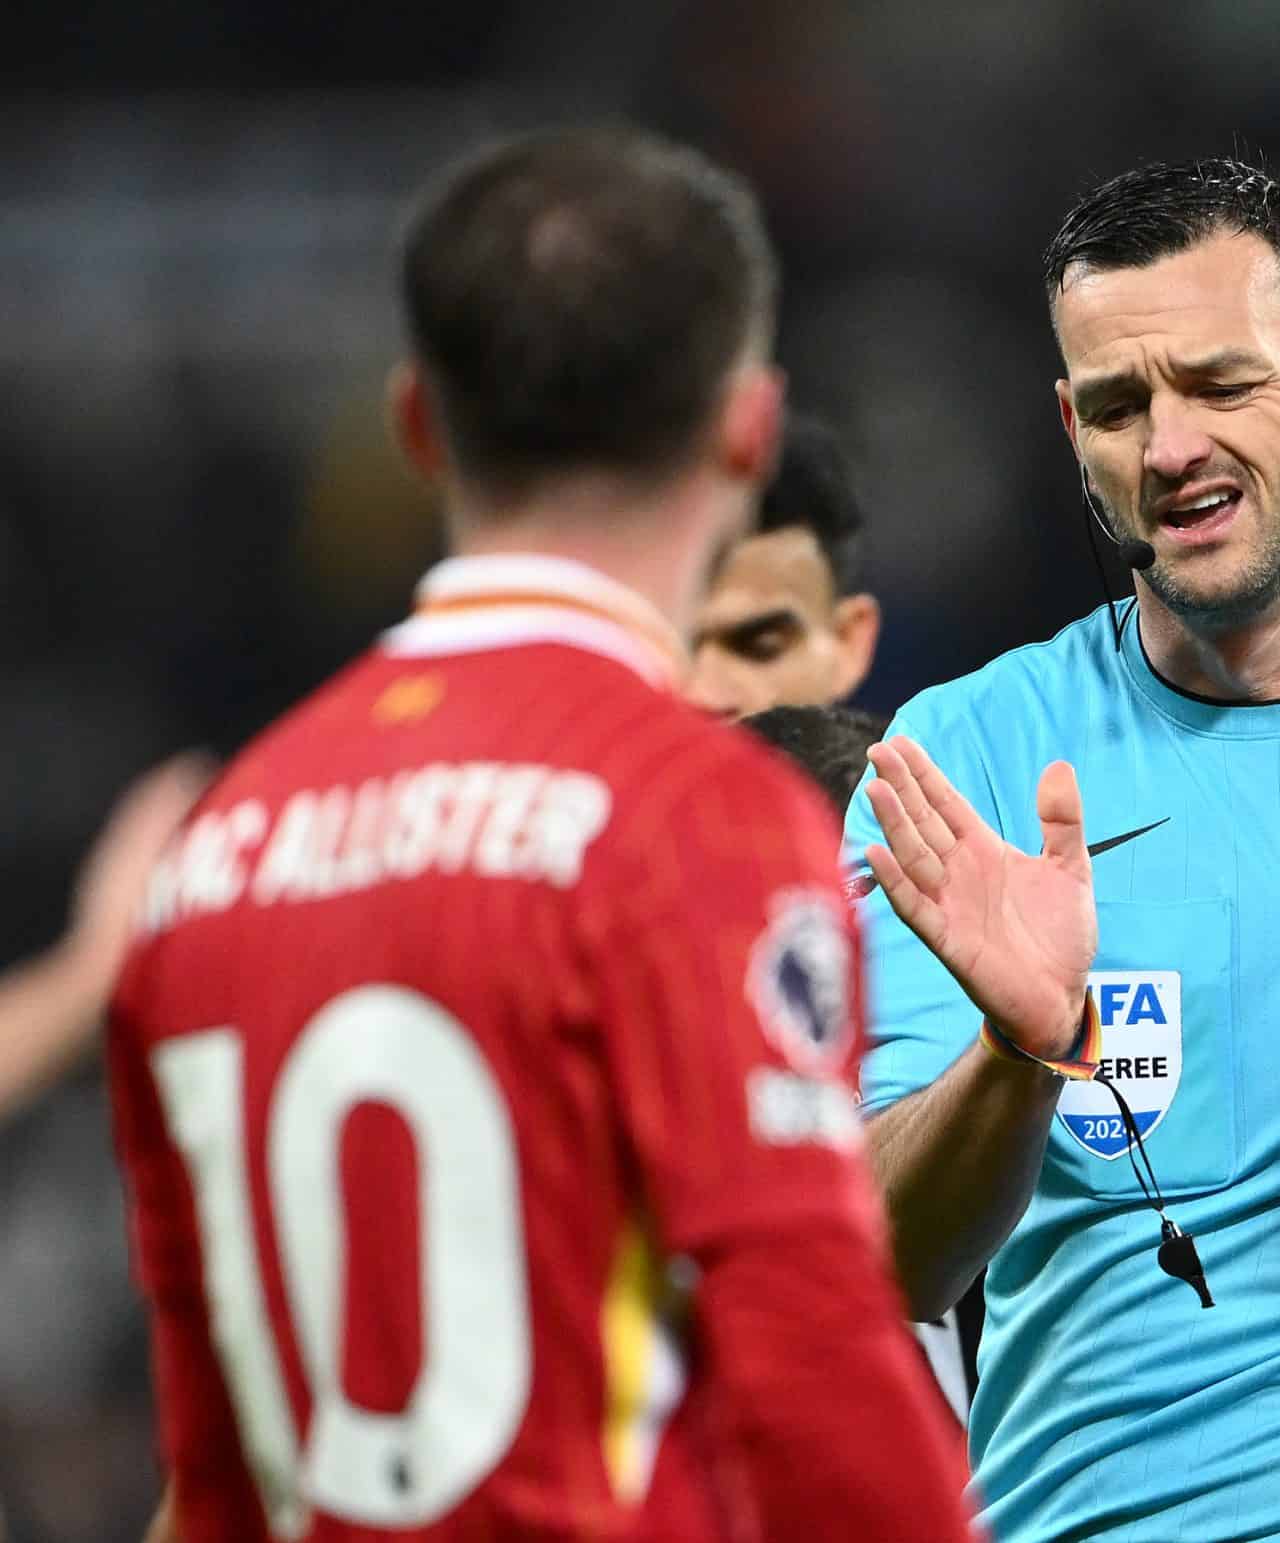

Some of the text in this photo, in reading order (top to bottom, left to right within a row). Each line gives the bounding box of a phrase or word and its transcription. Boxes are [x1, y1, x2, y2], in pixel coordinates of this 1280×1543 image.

[252, 760, 612, 890] ALLISTER
[1086, 983, 1168, 1026] FA
[151, 984, 533, 1541] 10
